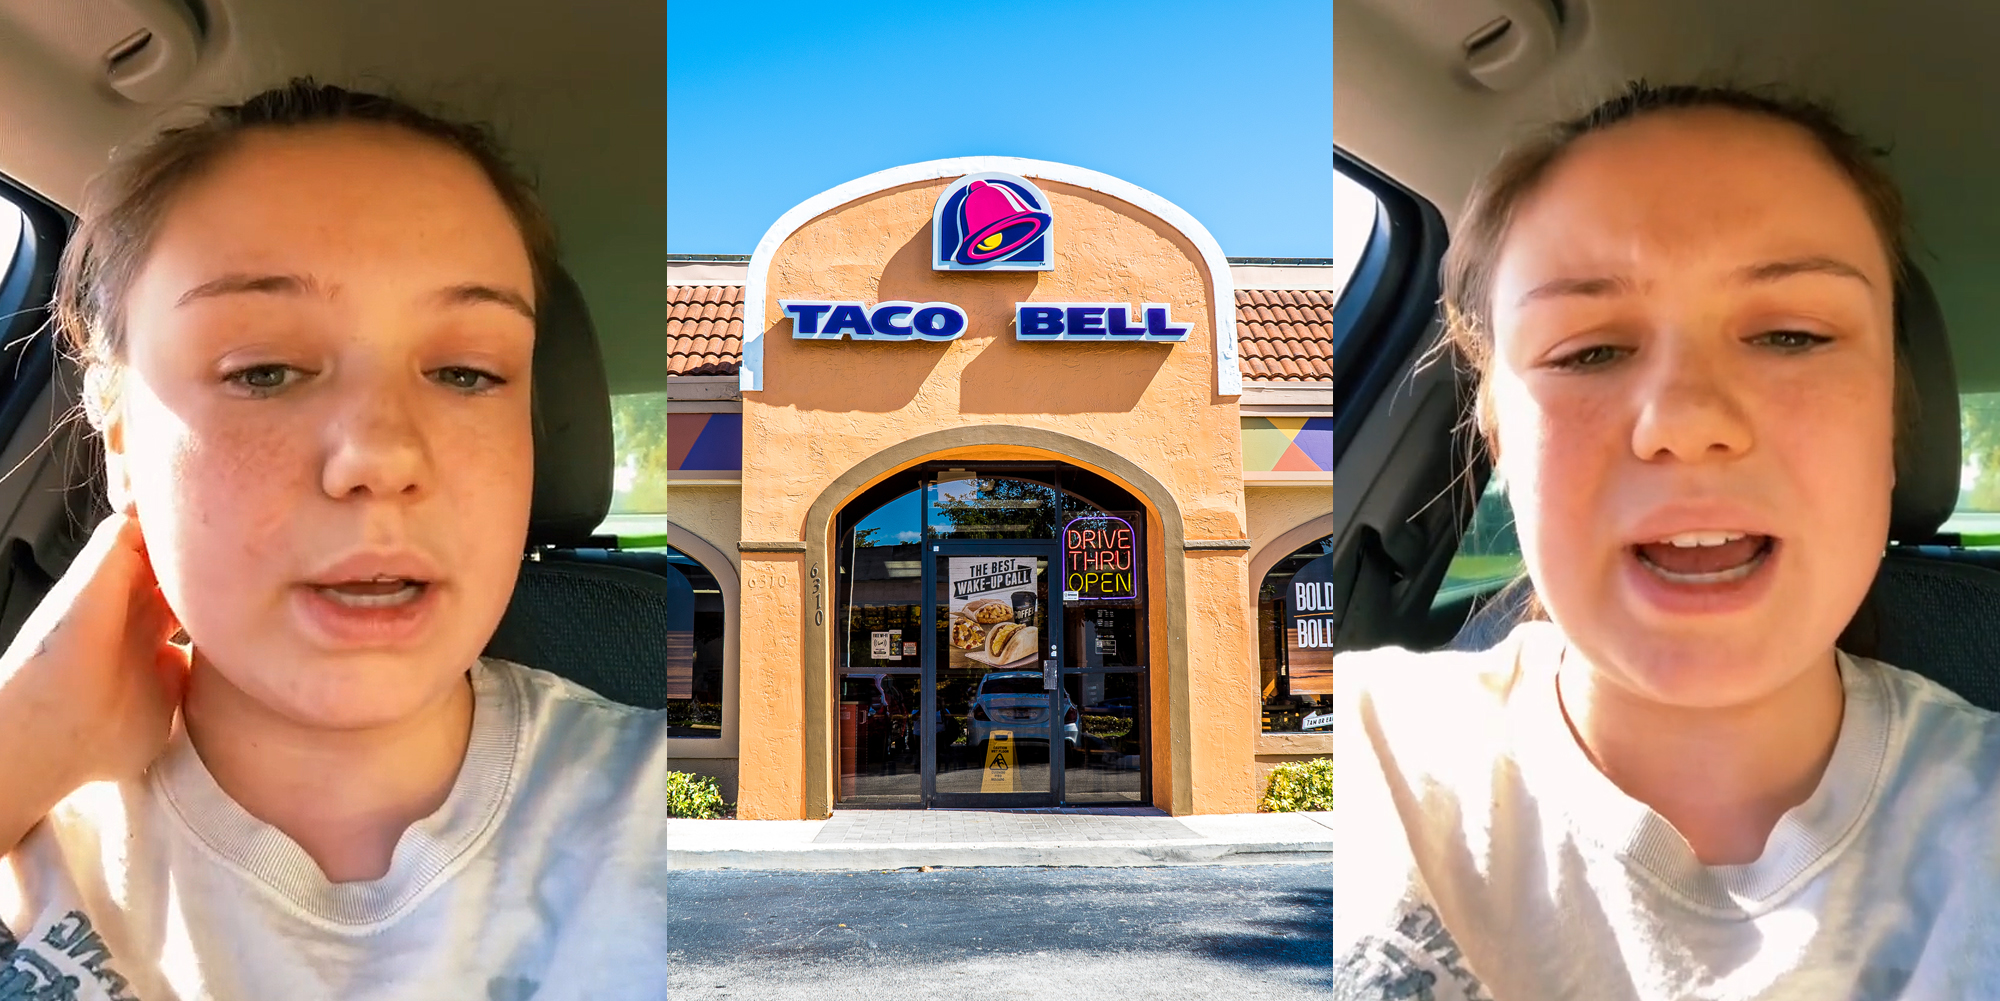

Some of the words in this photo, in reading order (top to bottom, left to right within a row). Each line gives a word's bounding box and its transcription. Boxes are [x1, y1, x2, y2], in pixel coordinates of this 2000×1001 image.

[786, 304, 965, 337] TACO
[1020, 307, 1187, 336] BELL
[1067, 529, 1131, 550] DRIVE
[969, 563, 988, 577] THE
[991, 558, 1016, 574] BEST
[1068, 550, 1131, 571] THRU
[747, 573, 788, 589] 6310
[957, 575, 1003, 595] WAKE-UP
[1005, 570, 1029, 587] CALL
[1068, 572, 1131, 593] OPEN
[810, 561, 824, 627] 6310
[1295, 582, 1333, 611] BOLD
